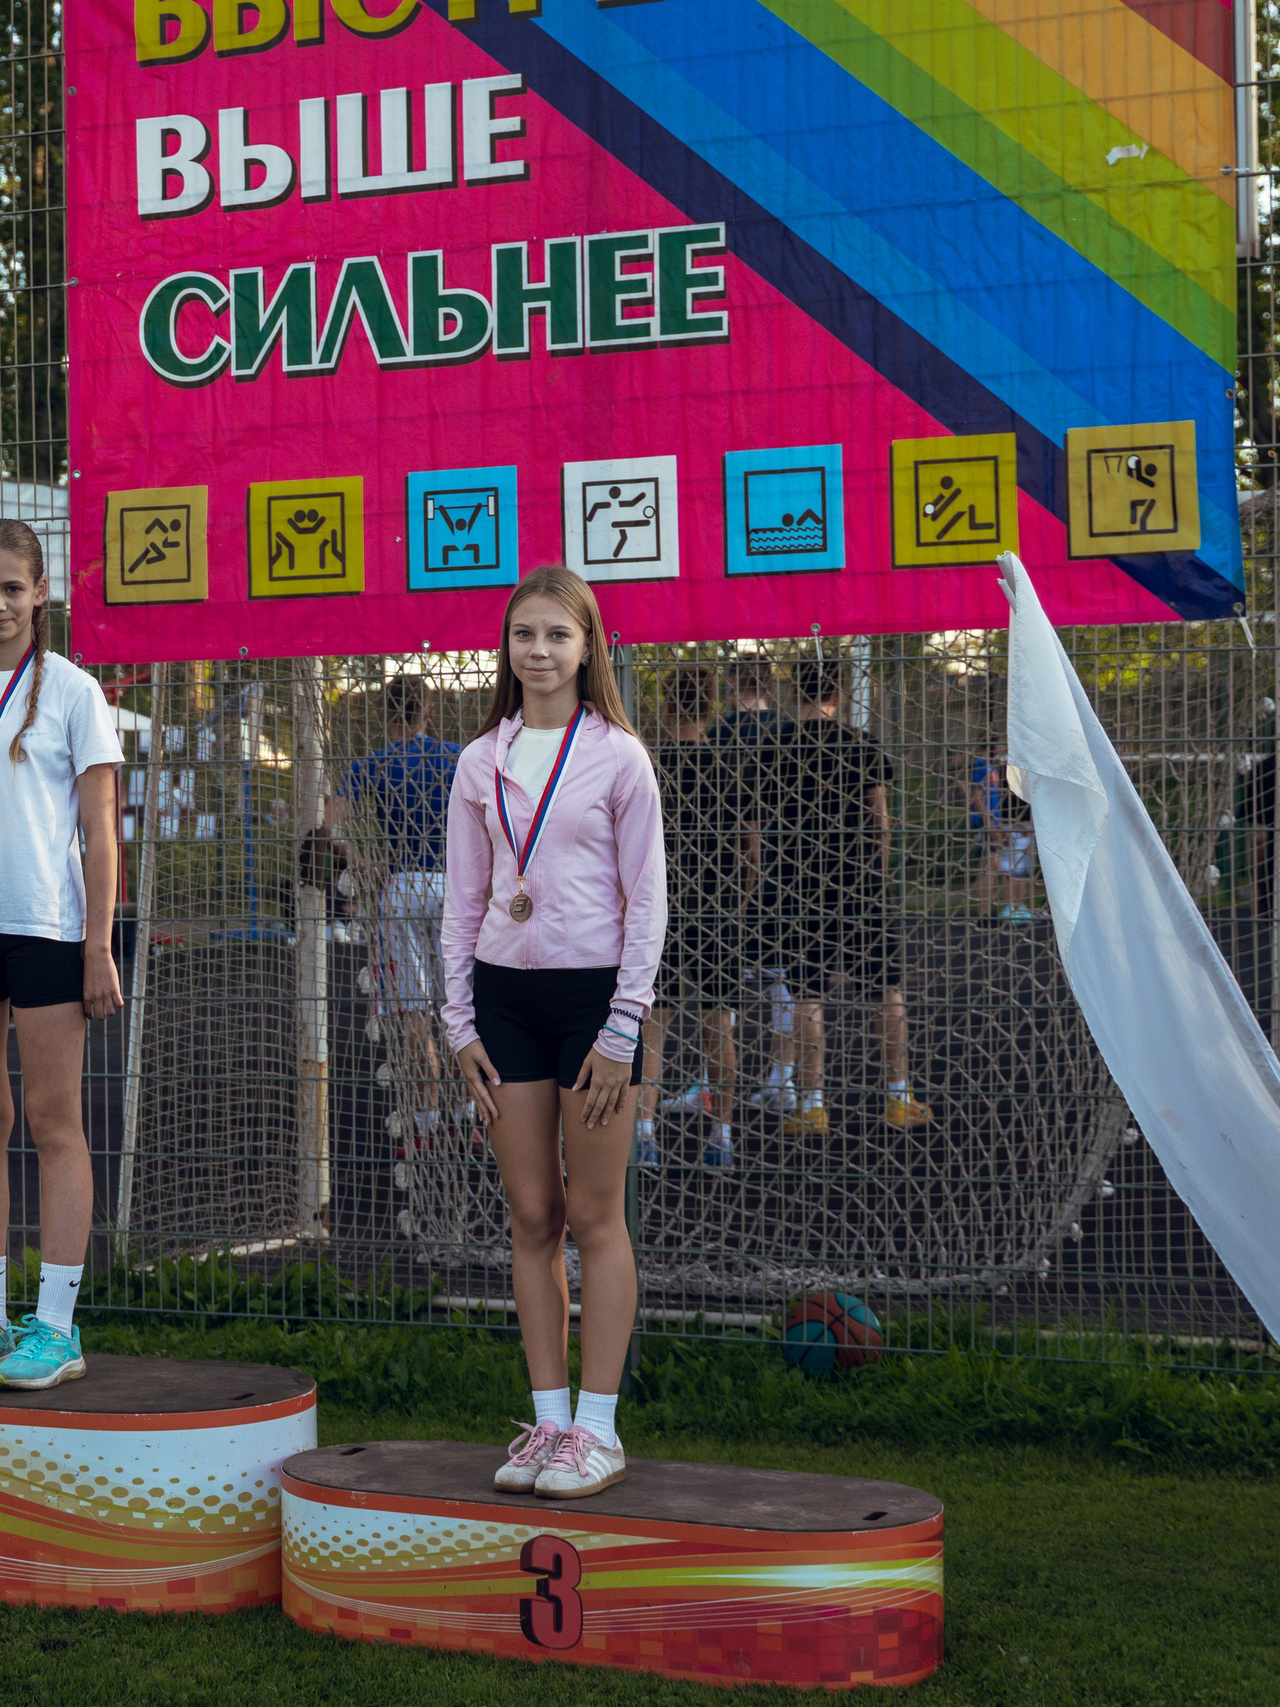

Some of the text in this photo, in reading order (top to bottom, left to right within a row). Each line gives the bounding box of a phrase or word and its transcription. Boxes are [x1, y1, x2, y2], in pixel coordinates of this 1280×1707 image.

[135, 73, 526, 218] ВЫШЕ
[139, 221, 730, 385] СИЛЬНЕЕ
[520, 1534, 583, 1650] 3
